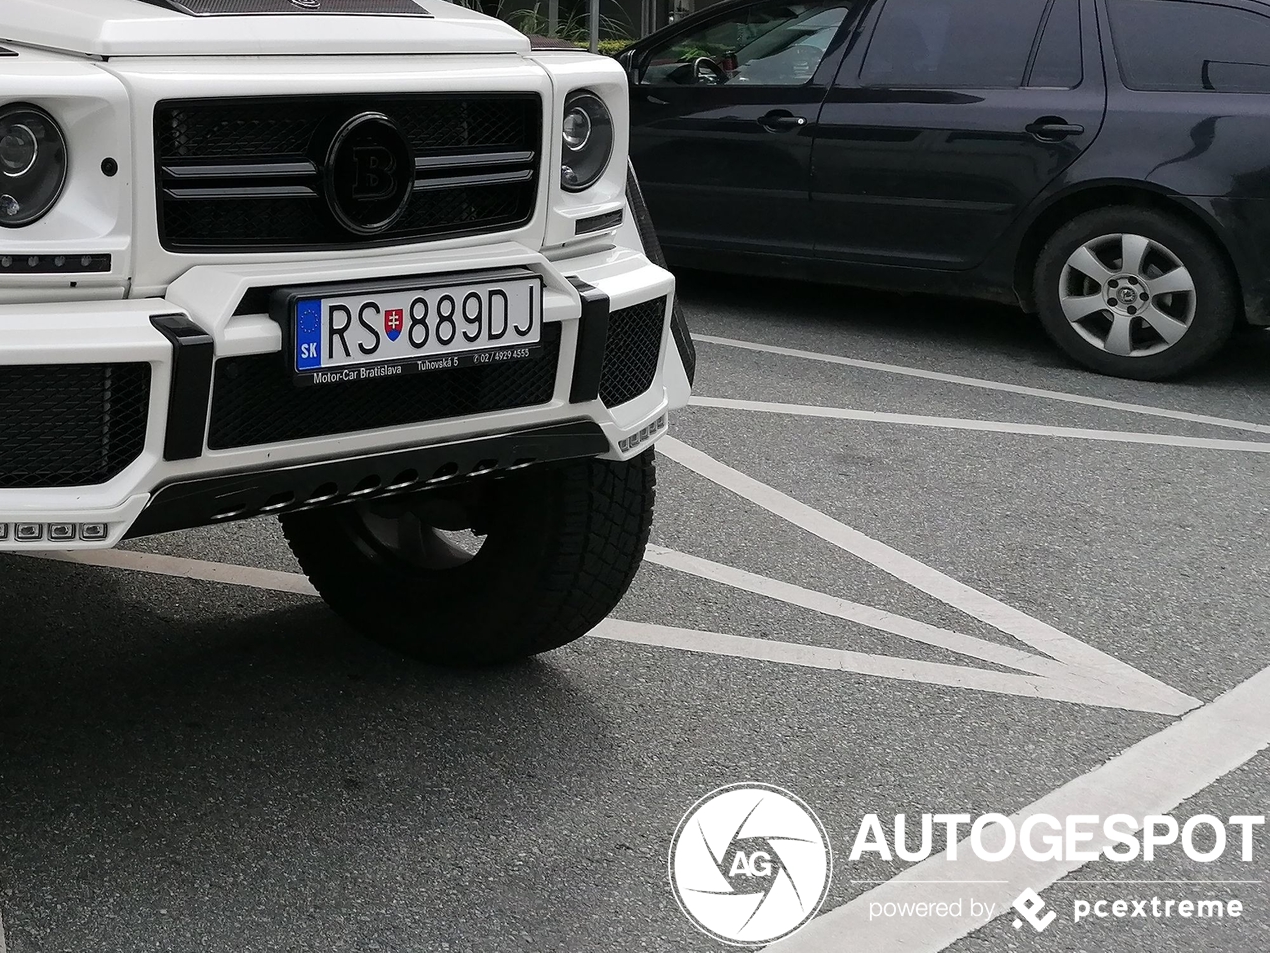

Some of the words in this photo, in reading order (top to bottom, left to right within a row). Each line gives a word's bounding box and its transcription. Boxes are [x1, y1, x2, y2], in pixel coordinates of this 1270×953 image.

[328, 301, 381, 360] RS
[408, 285, 534, 349] 889DJ
[301, 342, 318, 359] SK
[417, 359, 452, 370] Tuhovská
[313, 369, 358, 384] Motor-Car
[360, 364, 402, 379] Bratislava
